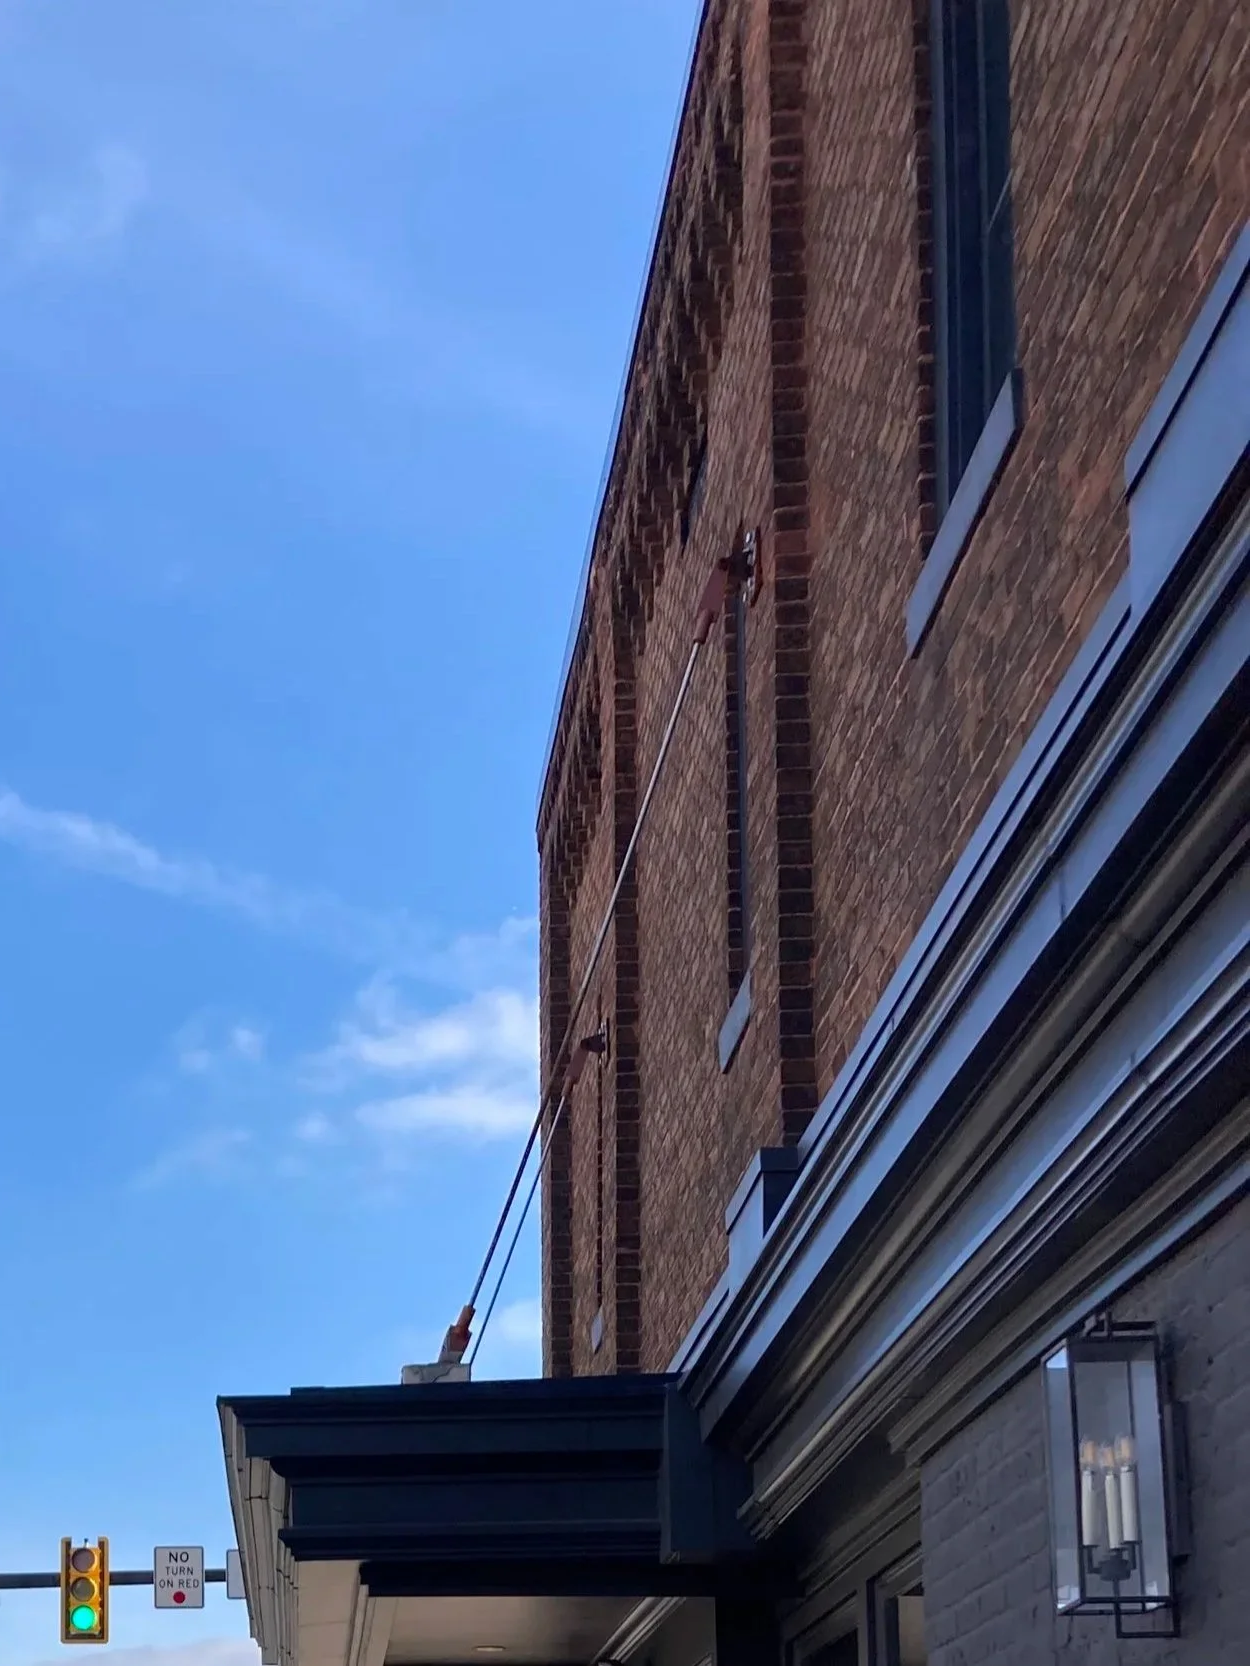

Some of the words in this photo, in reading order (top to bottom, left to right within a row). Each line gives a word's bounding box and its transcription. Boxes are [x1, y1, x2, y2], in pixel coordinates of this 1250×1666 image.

[169, 1551, 190, 1563] NO
[165, 1566, 194, 1576] TURN
[159, 1579, 174, 1588] ON
[178, 1579, 200, 1588] RED
